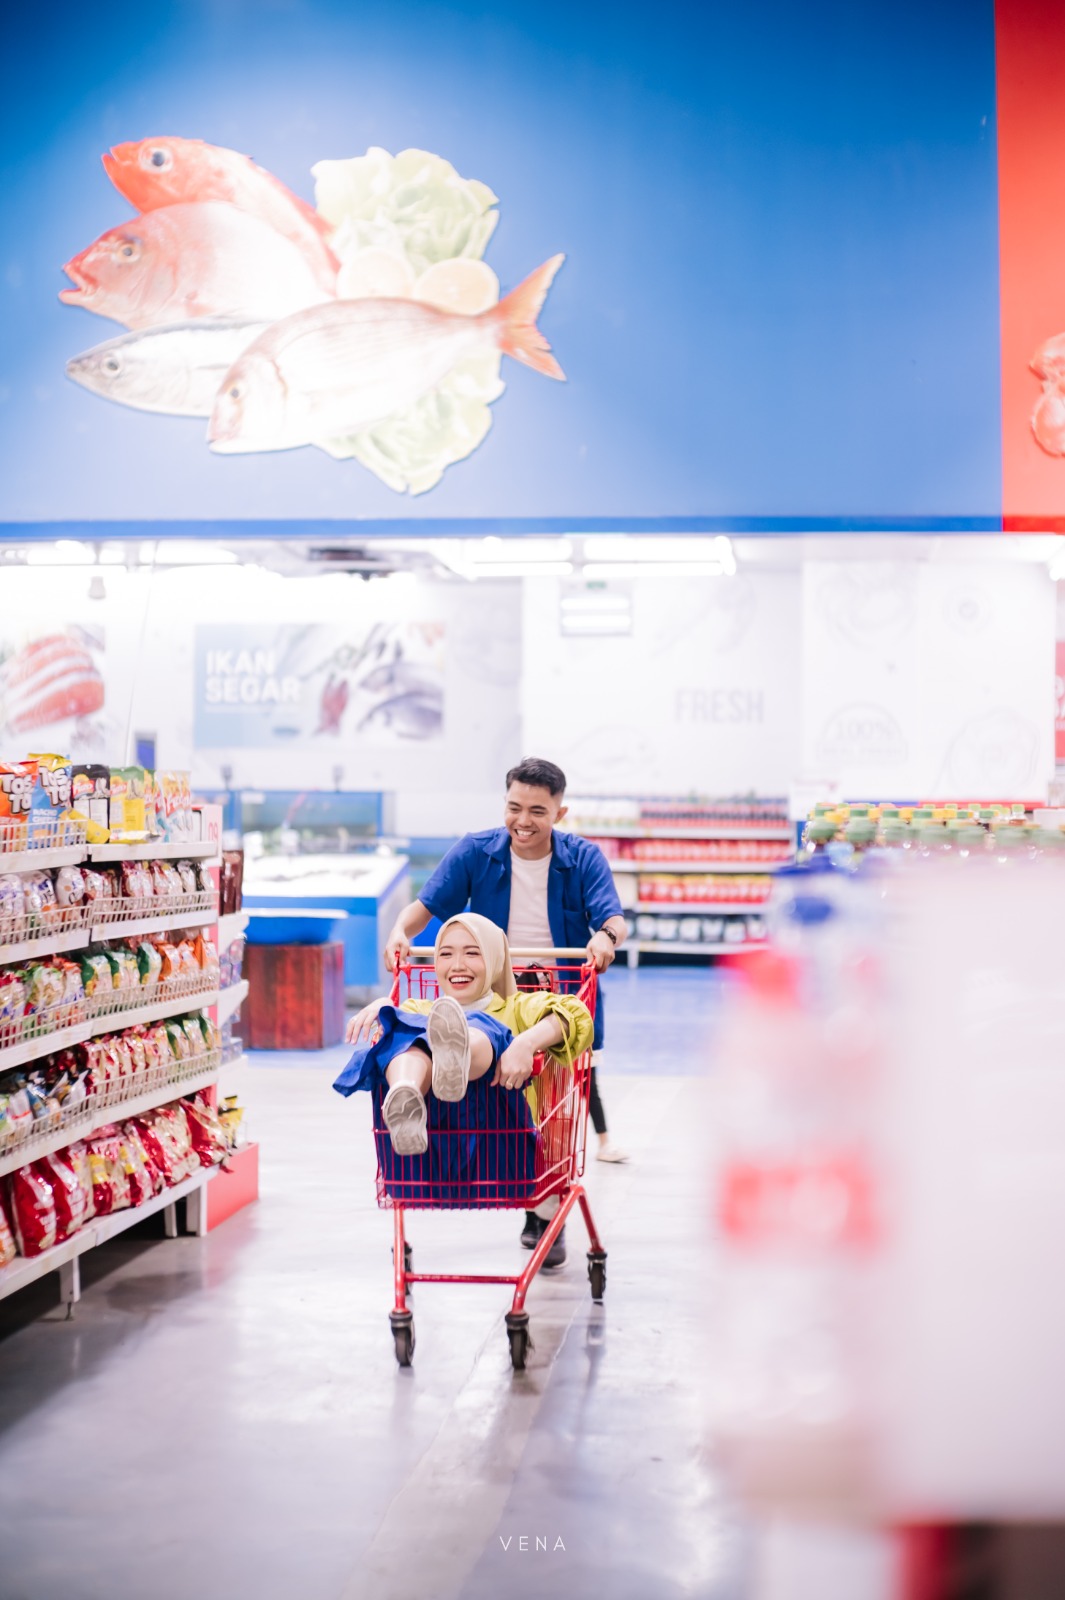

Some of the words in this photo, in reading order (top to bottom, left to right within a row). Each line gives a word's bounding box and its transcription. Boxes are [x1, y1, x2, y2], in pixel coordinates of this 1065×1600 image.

[206, 649, 275, 674] IKAN
[205, 676, 301, 703] SEGAR
[673, 687, 764, 724] FRESH
